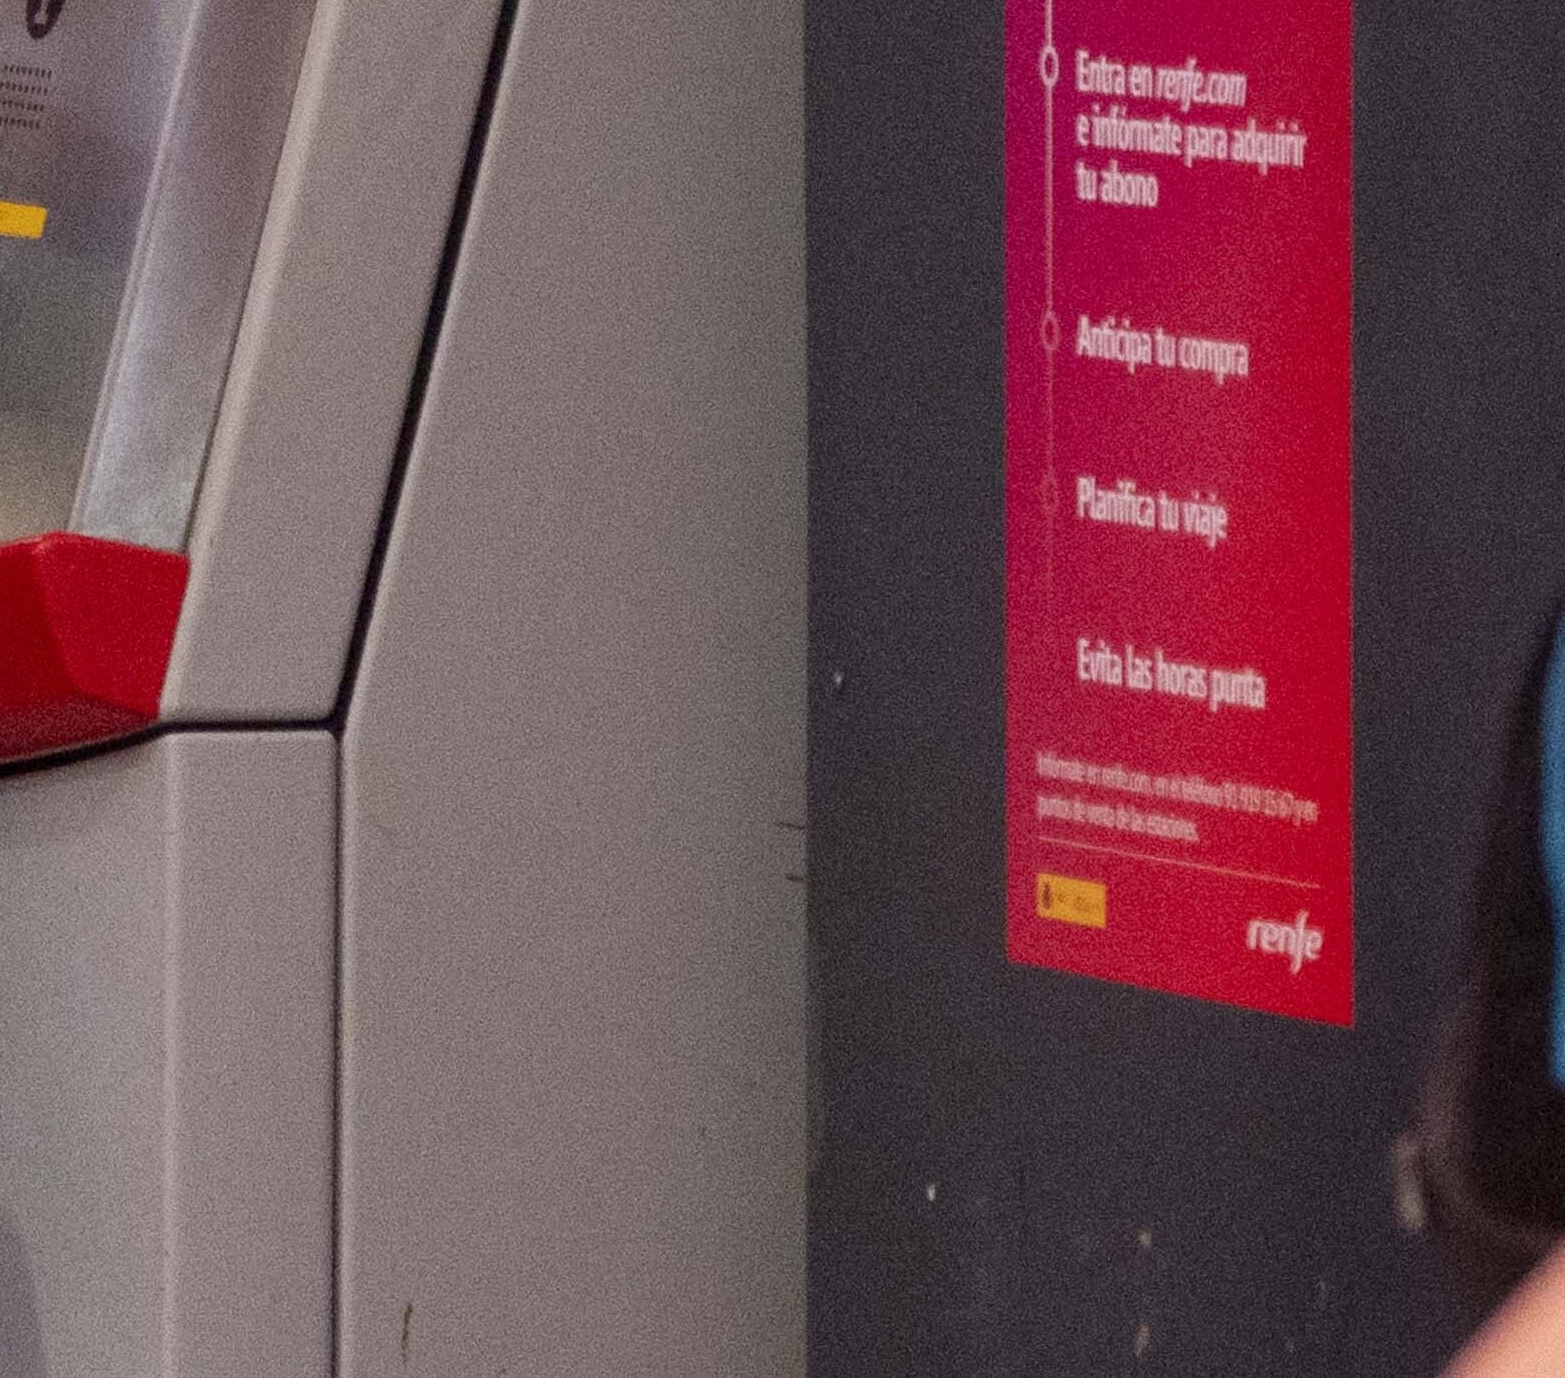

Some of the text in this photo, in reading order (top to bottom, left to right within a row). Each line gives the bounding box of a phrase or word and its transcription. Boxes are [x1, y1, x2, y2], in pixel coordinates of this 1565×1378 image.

[1075, 48, 1247, 113] Entra en renfe.com
[1075, 113, 1091, 148] e
[1184, 124, 1228, 168] para
[1230, 115, 1306, 176] adquirir
[1075, 158, 1159, 208] tu abono
[1076, 314, 1250, 386] Anticipa tu compra
[1077, 475, 1228, 549] Planifica tu viaje
[1076, 637, 1267, 714] Evita las horas punta
[1246, 910, 1322, 976] renfe
